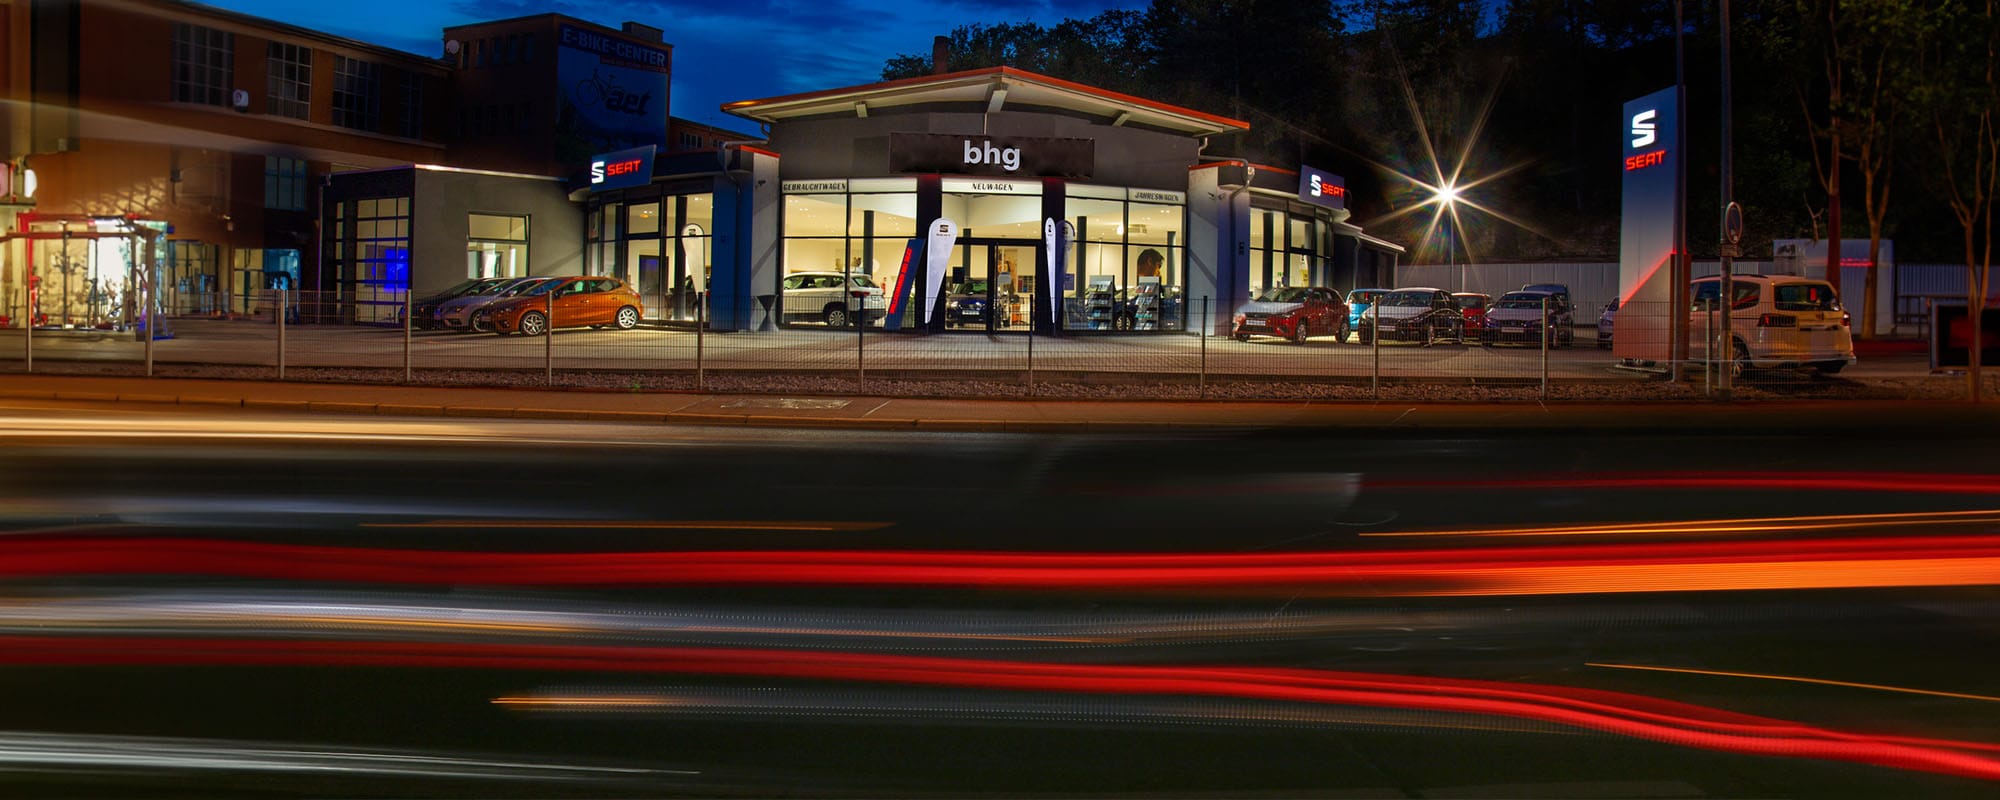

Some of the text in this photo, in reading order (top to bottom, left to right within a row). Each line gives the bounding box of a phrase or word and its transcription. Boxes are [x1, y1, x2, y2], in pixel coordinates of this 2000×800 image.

[562, 27, 665, 67] E-BIKE-CENTER
[964, 140, 1020, 171] bhg
[1625, 150, 1666, 171] SEAT
[607, 159, 641, 177] SEAT
[783, 183, 846, 191] GEBRAUCHTWAGEN
[972, 183, 1014, 191] NEUWAGEN
[1322, 182, 1345, 199] SEAT
